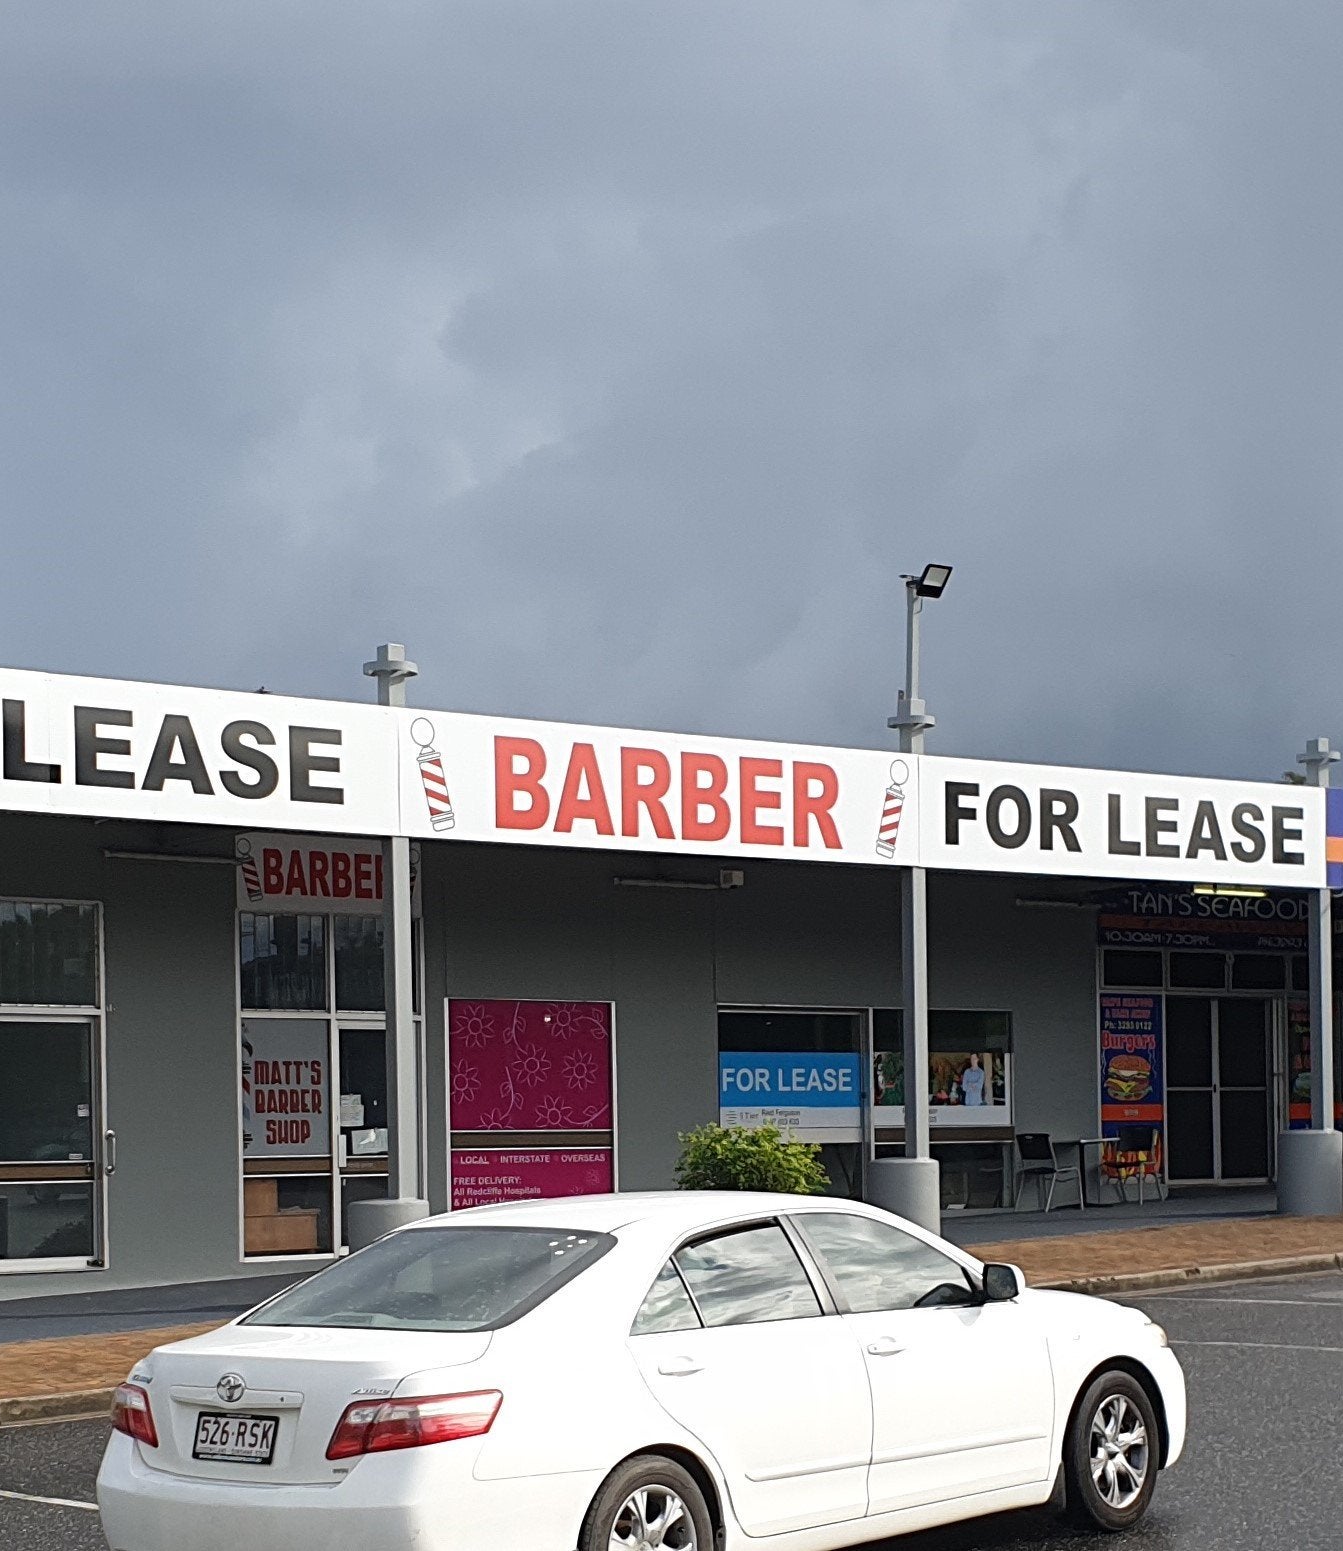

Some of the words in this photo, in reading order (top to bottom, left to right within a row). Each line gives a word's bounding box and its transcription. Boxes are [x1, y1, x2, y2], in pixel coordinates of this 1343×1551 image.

[1, 698, 346, 806] LEASE
[493, 735, 843, 850] BARBER
[944, 781, 1082, 853] FOR
[1107, 793, 1305, 866] LEASE
[1128, 891, 1192, 916] TAN'S
[1102, 1030, 1155, 1053] Burgers
[254, 1060, 322, 1085] MATT'S
[722, 1068, 771, 1092] FOR
[778, 1068, 852, 1092] LEASE
[255, 1089, 322, 1114] BARBER
[266, 1119, 311, 1144] SHOP
[460, 1156, 490, 1165] LOCAL
[500, 1154, 550, 1163] INTERSTATE
[561, 1154, 606, 1162] OVERSEAS
[453, 1177, 475, 1185] FREE
[453, 1187, 465, 1196] All
[467, 1187, 502, 1196] Redcliffe
[461, 1198, 473, 1207] All
